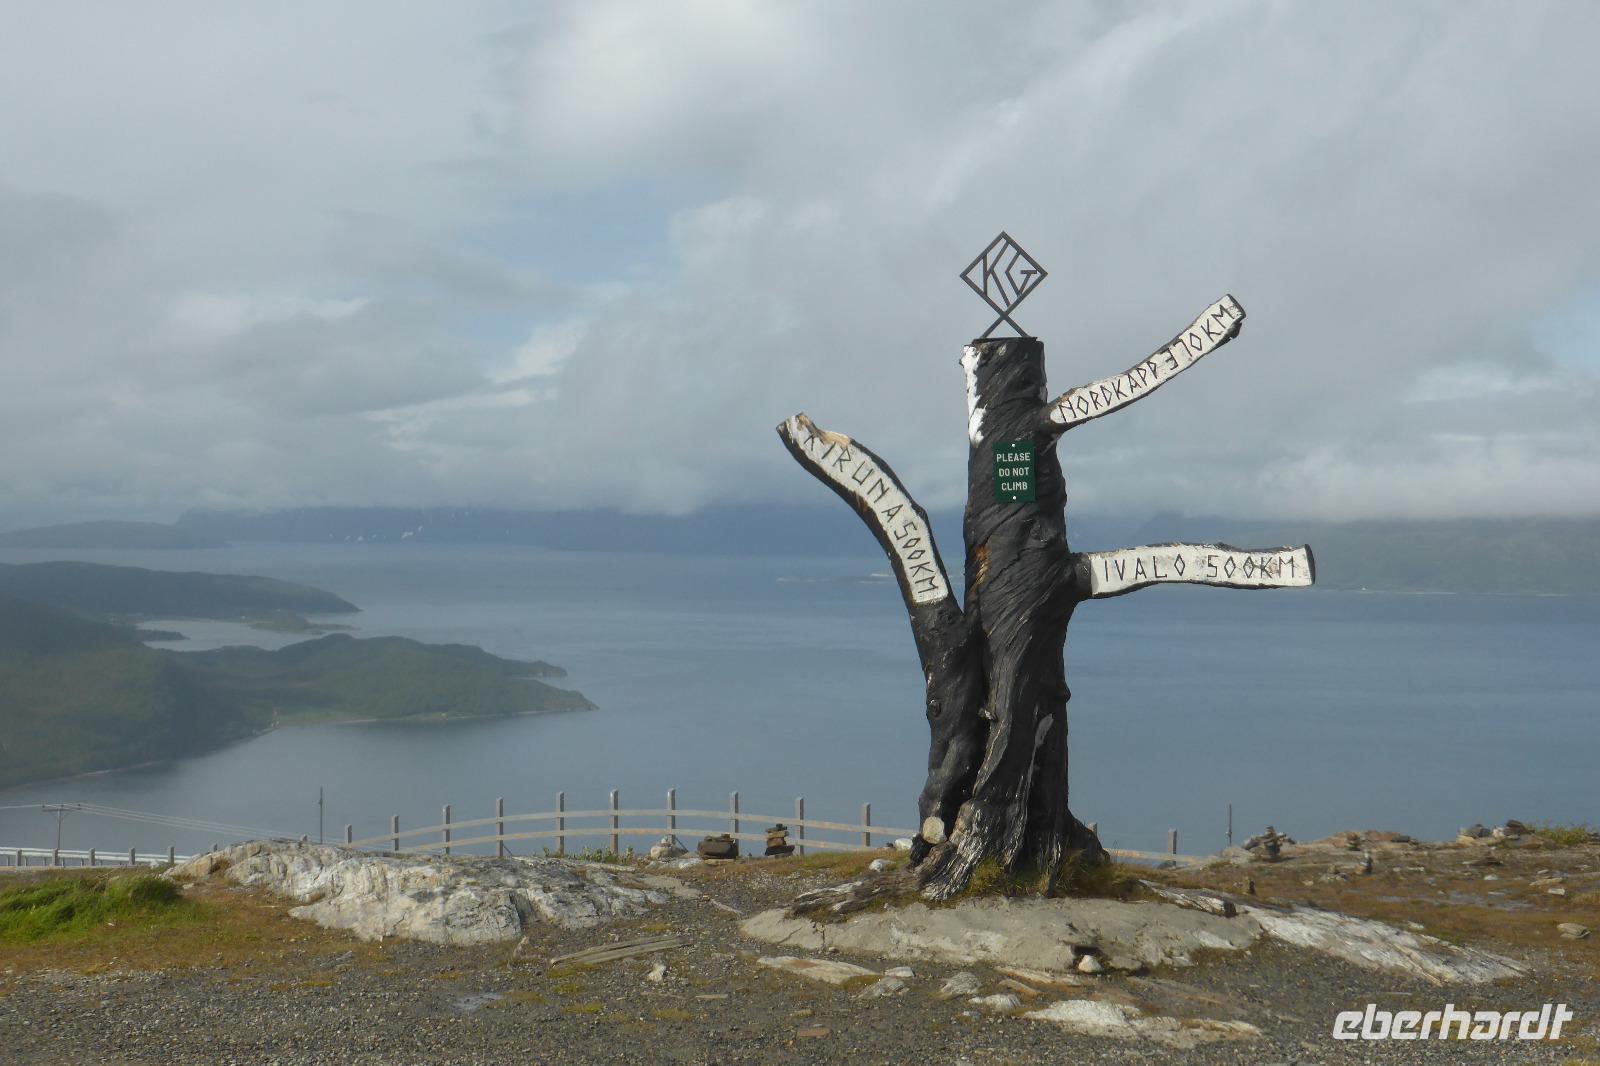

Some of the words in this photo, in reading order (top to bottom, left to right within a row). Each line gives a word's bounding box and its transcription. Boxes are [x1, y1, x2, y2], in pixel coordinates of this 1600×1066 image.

[1058, 360, 1158, 422] NORDKAPP
[996, 452, 1031, 462] PLEASE
[803, 433, 904, 523] KIRUNA
[998, 468, 1010, 477] DO
[1012, 467, 1030, 476] NOT
[1001, 482, 1028, 491] CLIMB
[1104, 553, 1186, 582] IVALO
[1206, 554, 1295, 579] 500KM
